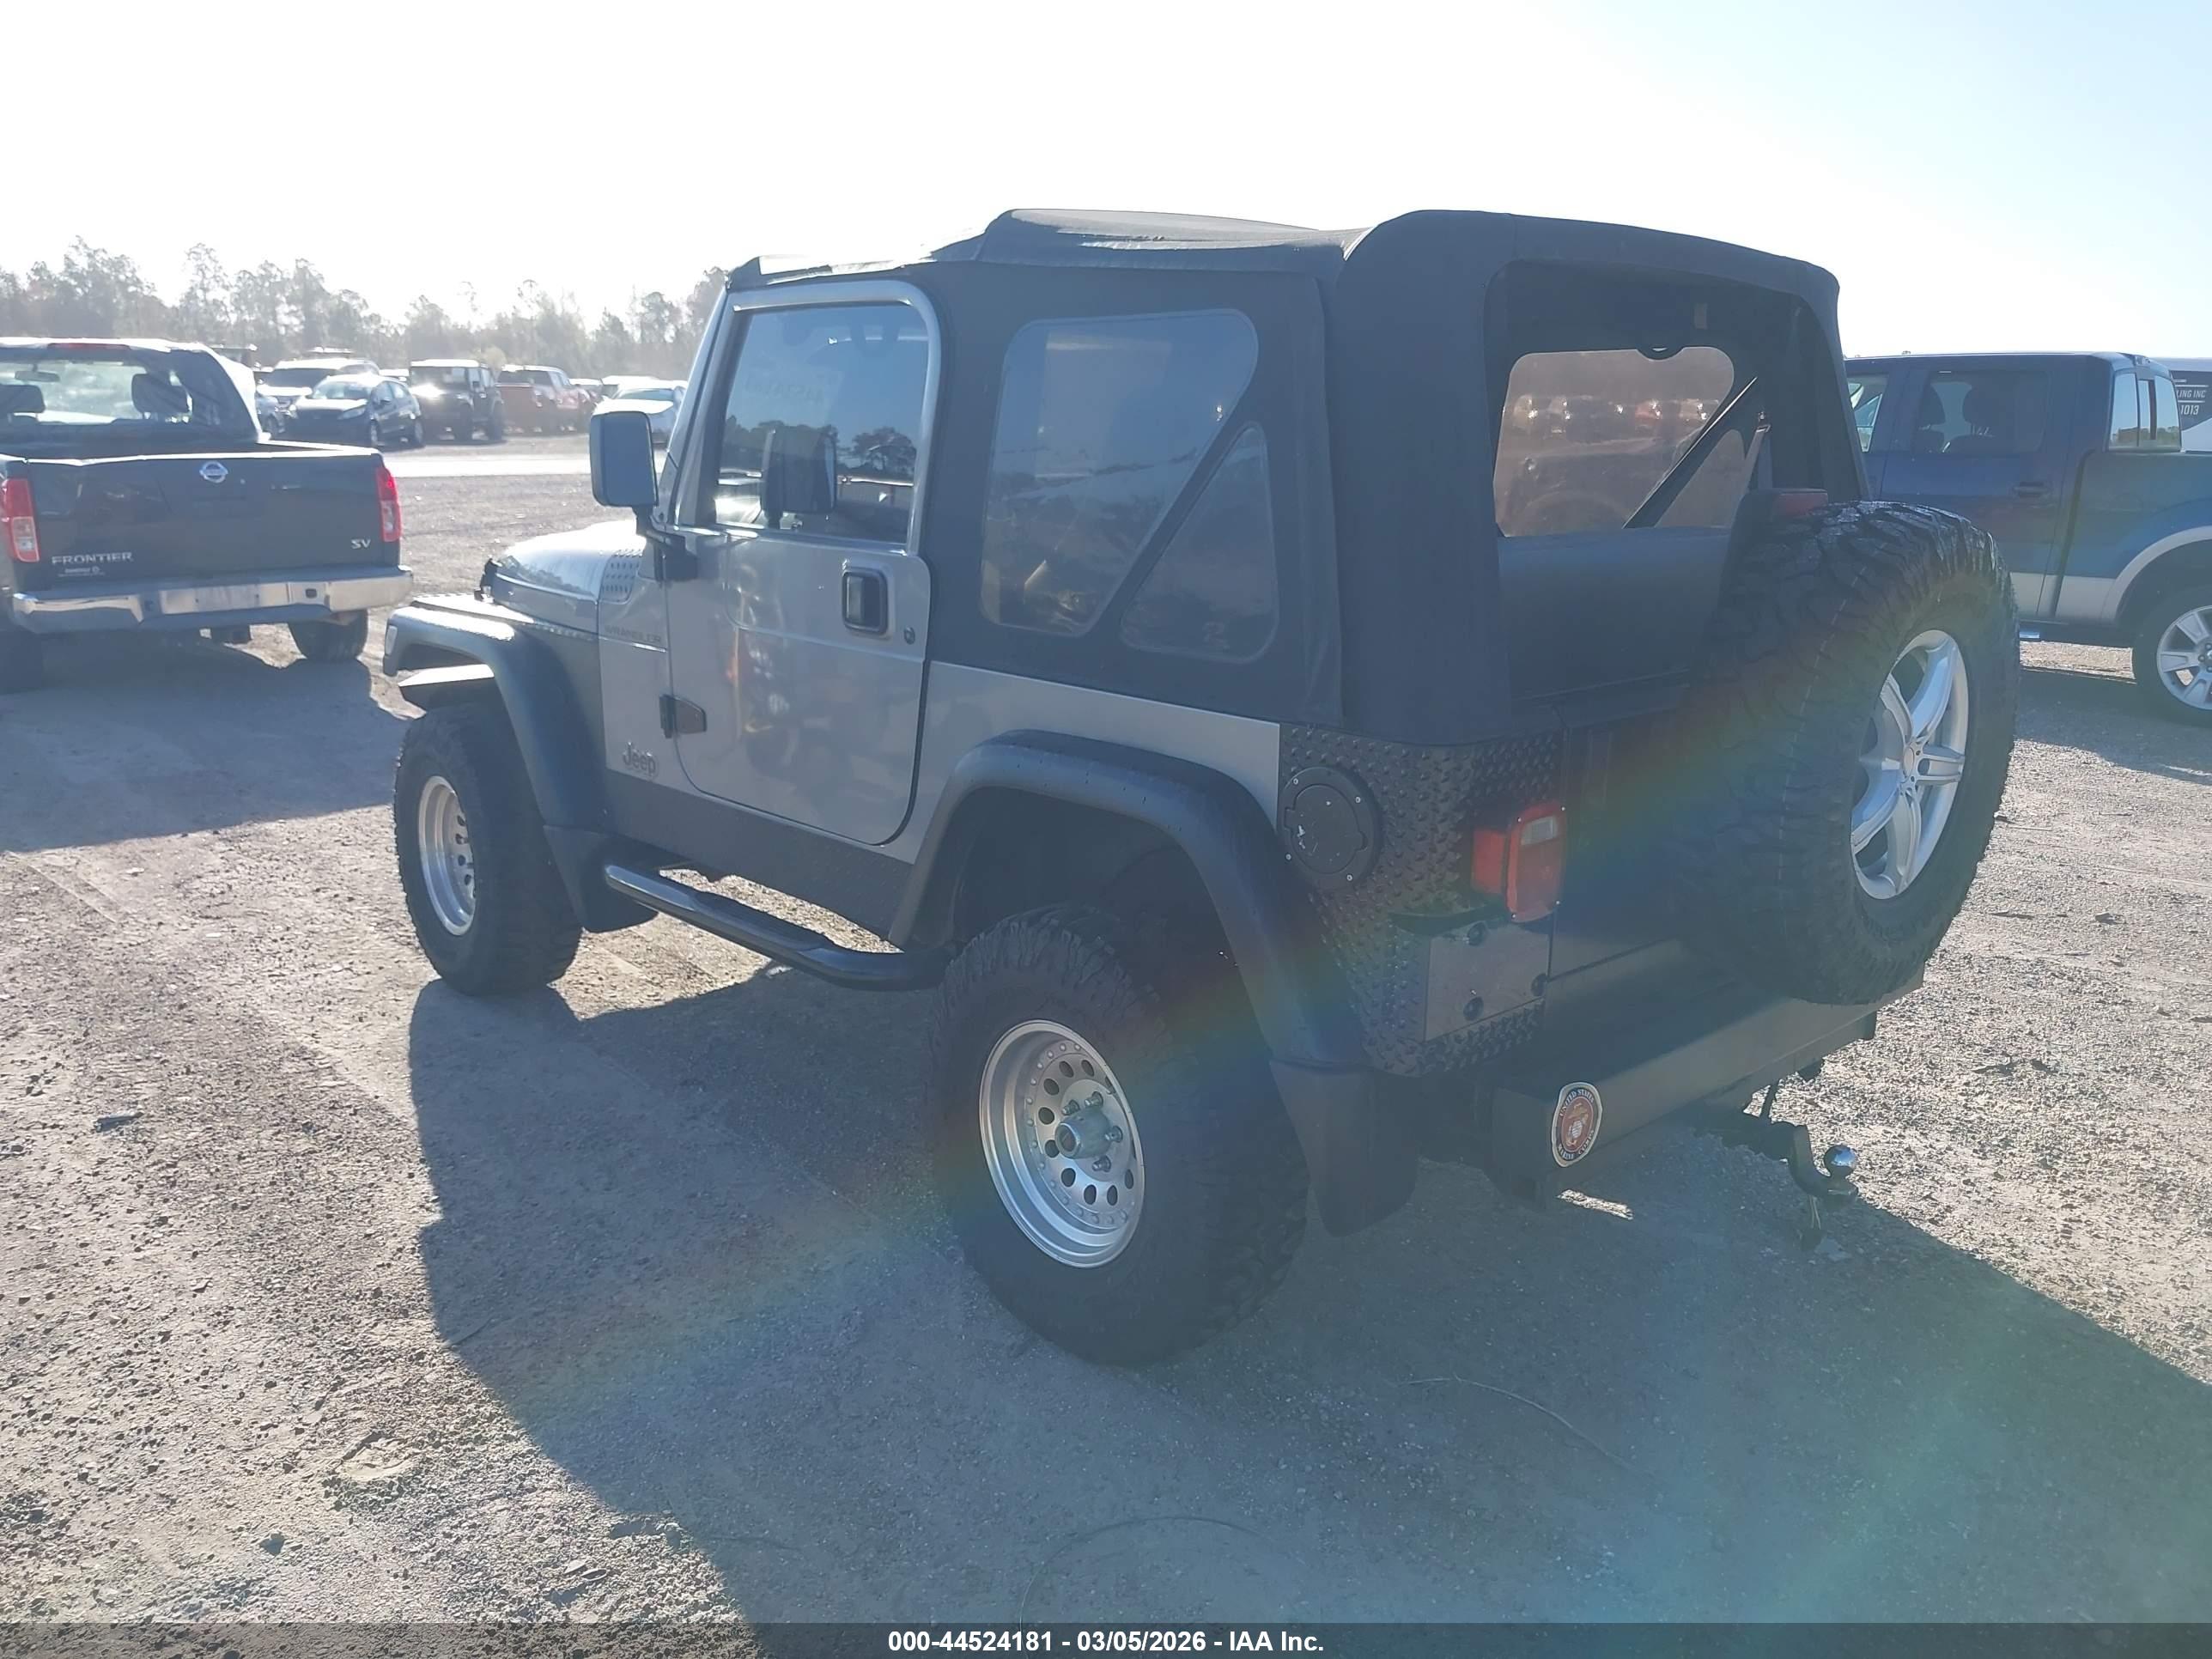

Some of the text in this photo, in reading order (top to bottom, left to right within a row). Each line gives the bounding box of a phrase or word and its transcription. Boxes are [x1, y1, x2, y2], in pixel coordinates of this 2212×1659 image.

[2193, 389, 2206, 398] INC
[2181, 404, 2199, 416] 1013
[351, 538, 371, 550] SV
[52, 552, 133, 564] FRONTIER
[623, 741, 657, 777] Jeep
